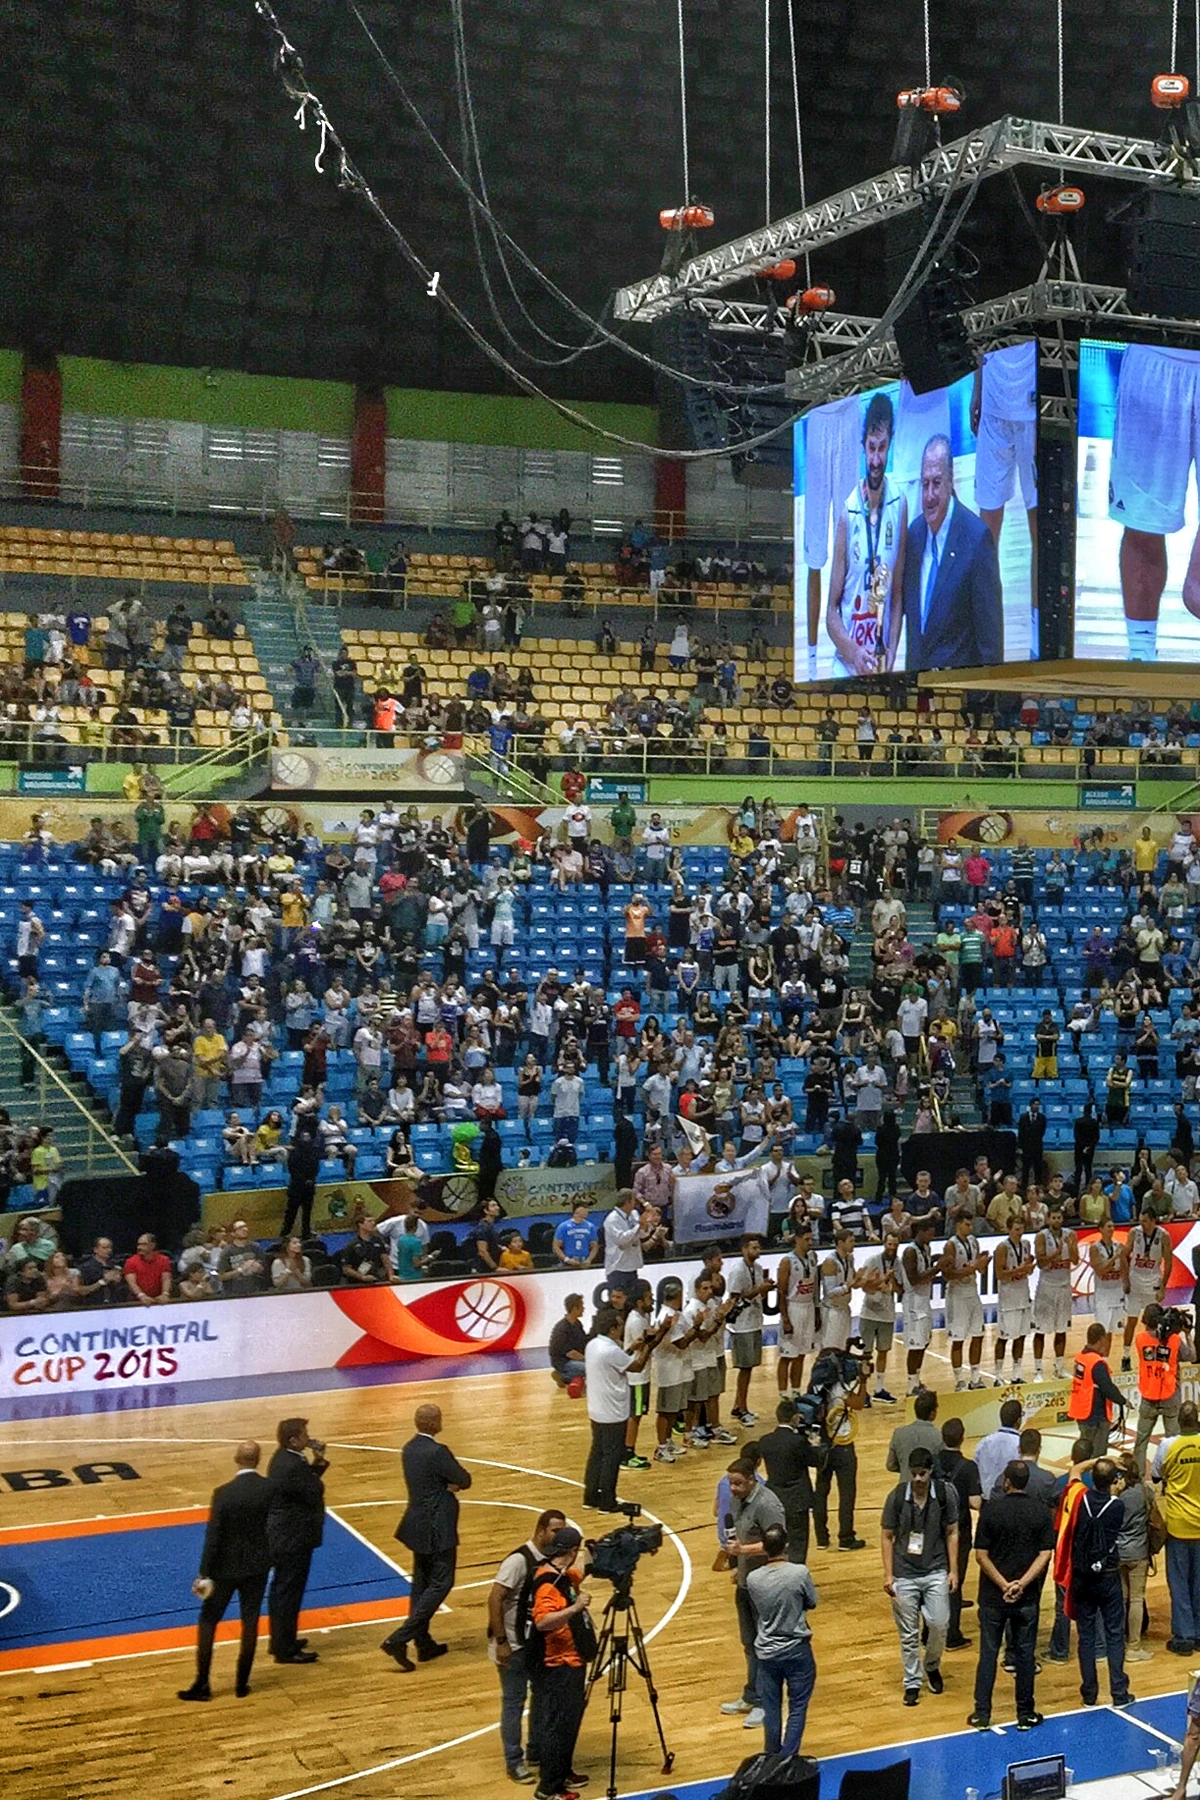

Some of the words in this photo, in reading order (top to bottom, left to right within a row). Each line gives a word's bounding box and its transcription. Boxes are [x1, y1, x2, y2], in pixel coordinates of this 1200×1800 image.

[14, 1319, 219, 1357] CONTINENTAL
[13, 1355, 87, 1386] CUP
[93, 1347, 179, 1382] 2015
[1183, 1367, 1198, 1380] CUP
[0, 1462, 142, 1493] BA
